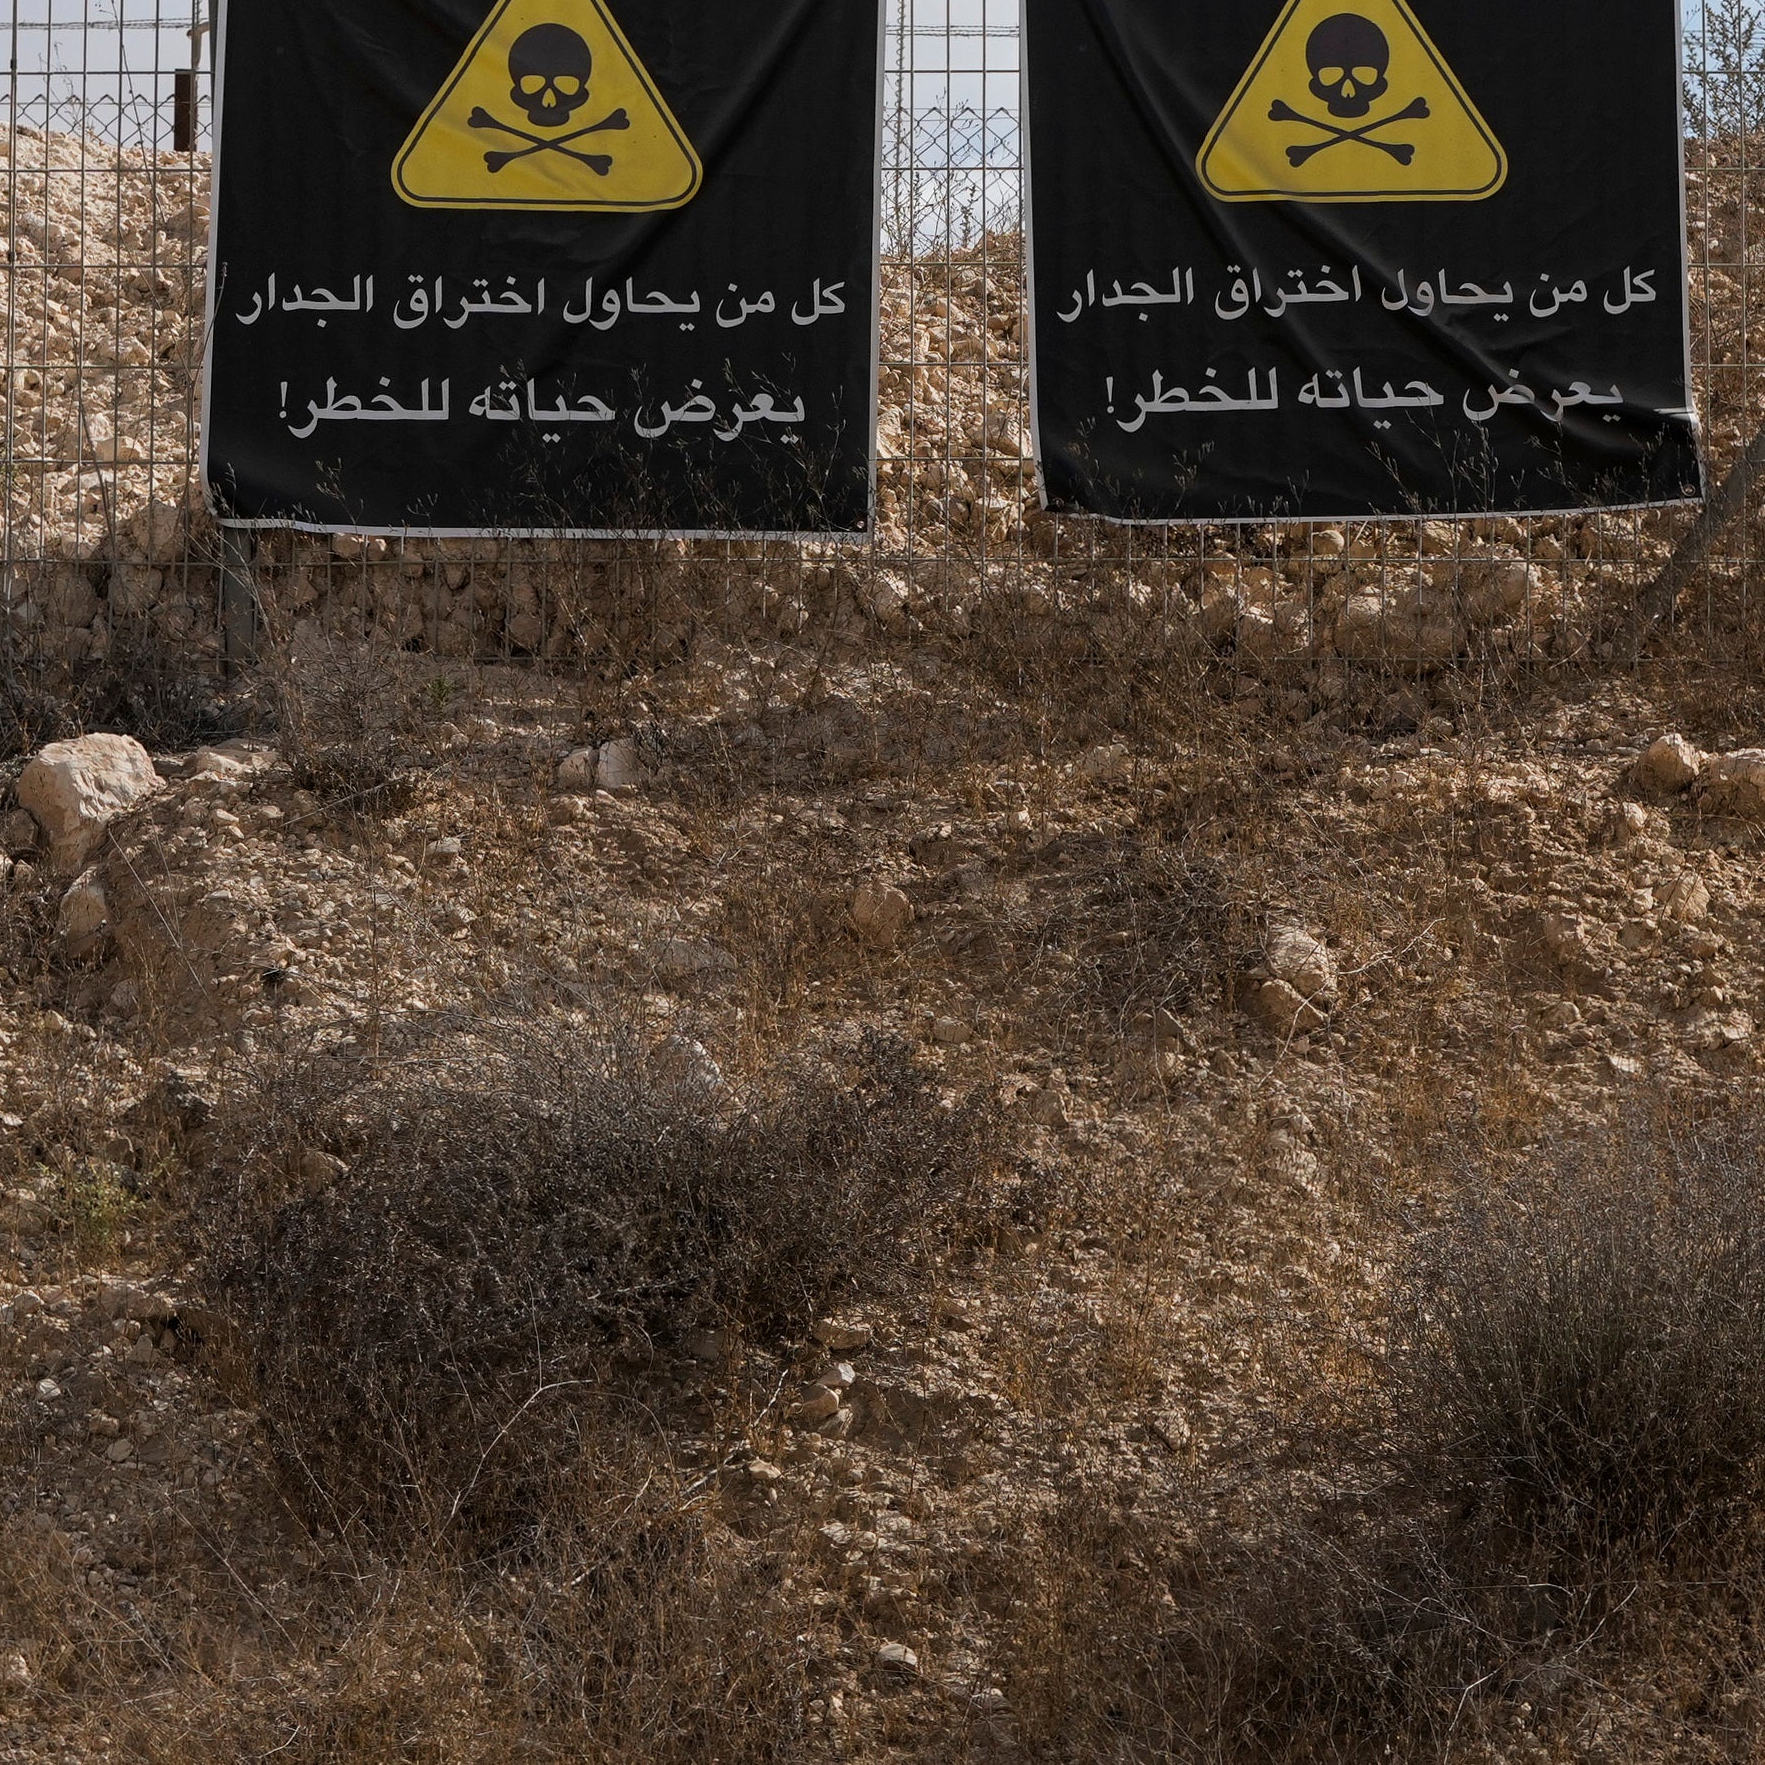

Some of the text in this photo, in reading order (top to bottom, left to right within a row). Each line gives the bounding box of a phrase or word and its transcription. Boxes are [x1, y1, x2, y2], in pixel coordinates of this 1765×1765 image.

[235, 272, 846, 331] كل من يحاول اختراق الجدار
[1056, 265, 1657, 323] كل من يحاول اختراق الجدار
[278, 376, 805, 444] يعرض حياته للخطر!
[1106, 366, 1624, 433] يعرض حياته للخطر!
